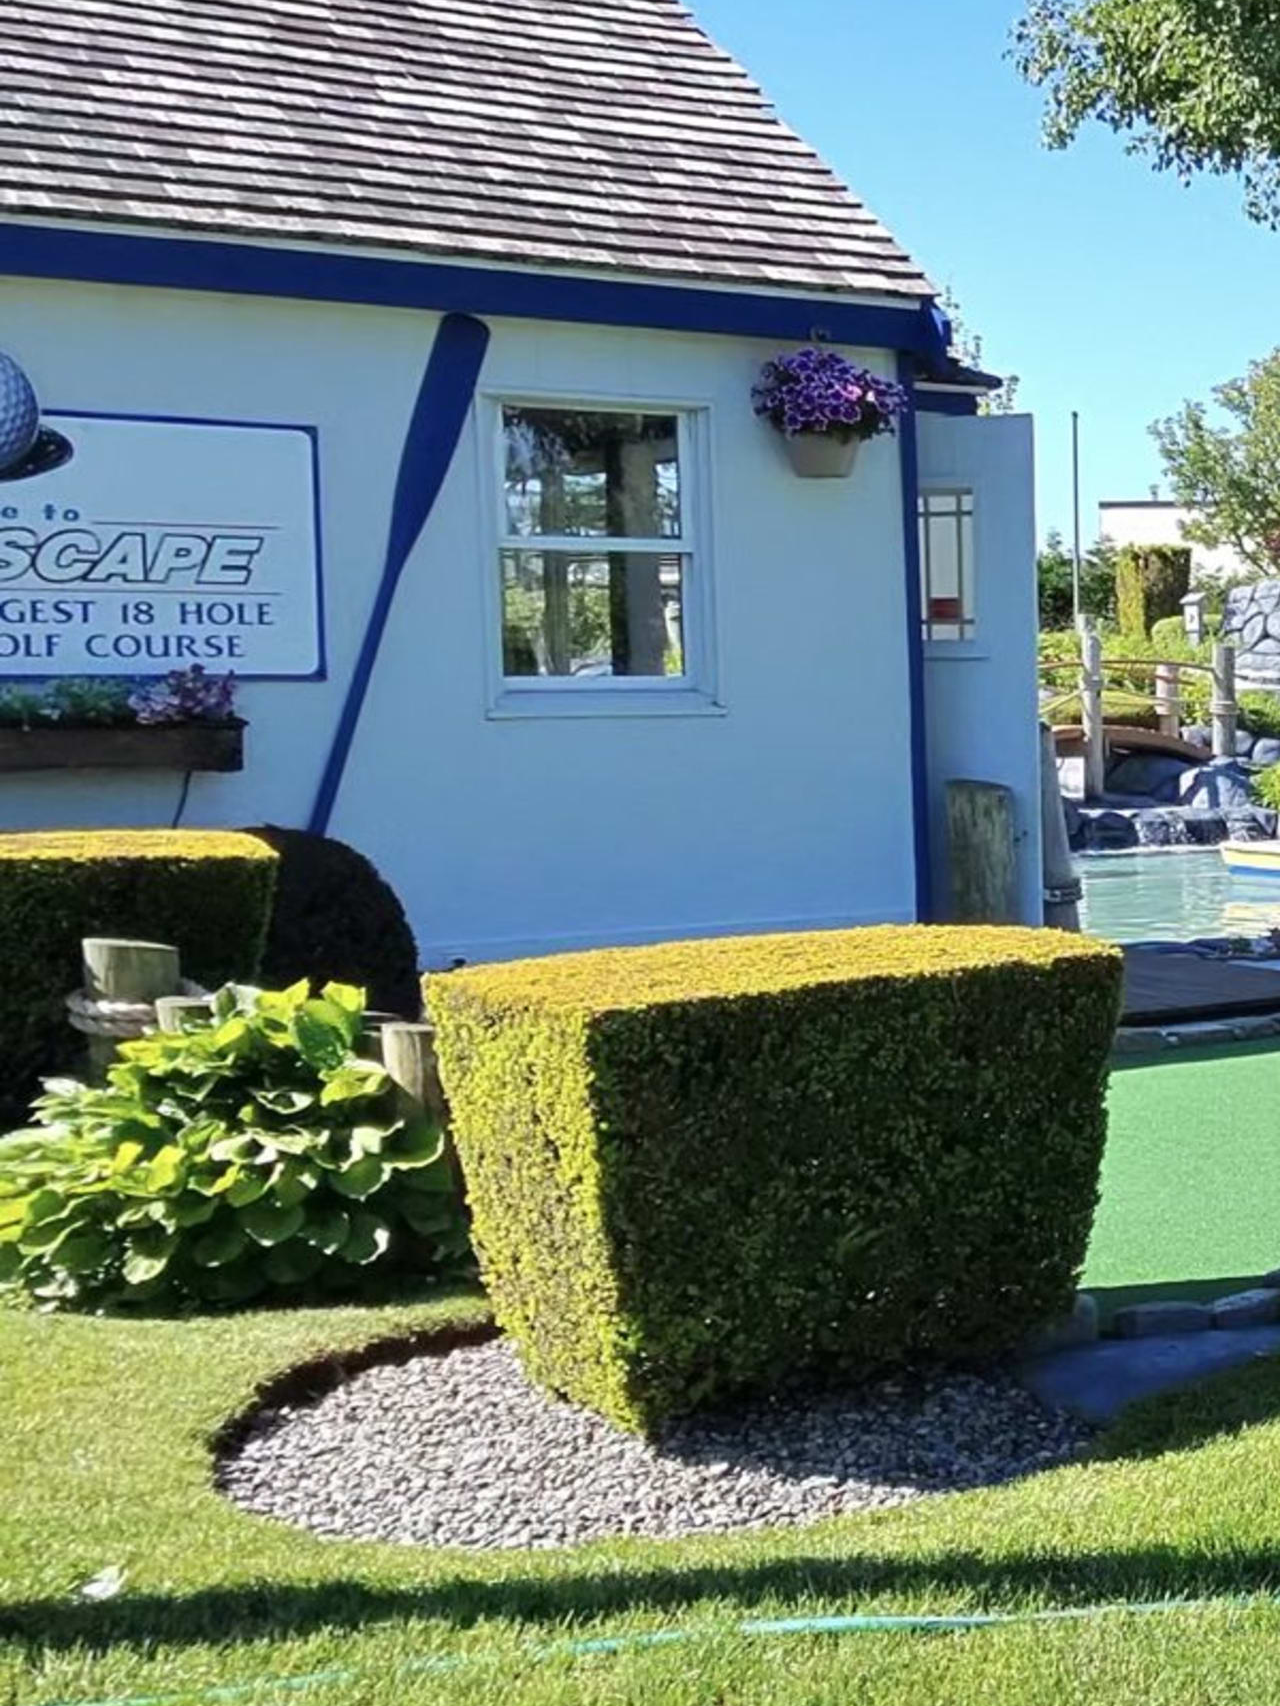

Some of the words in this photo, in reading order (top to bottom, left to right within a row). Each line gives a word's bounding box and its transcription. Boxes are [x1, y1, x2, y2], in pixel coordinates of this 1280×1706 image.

[45, 504, 80, 521] to
[0, 598, 96, 624] GEST
[122, 601, 154, 625] 18
[179, 602, 273, 625] HOLE
[0, 633, 61, 657] OLF
[85, 633, 245, 658] COURSE
